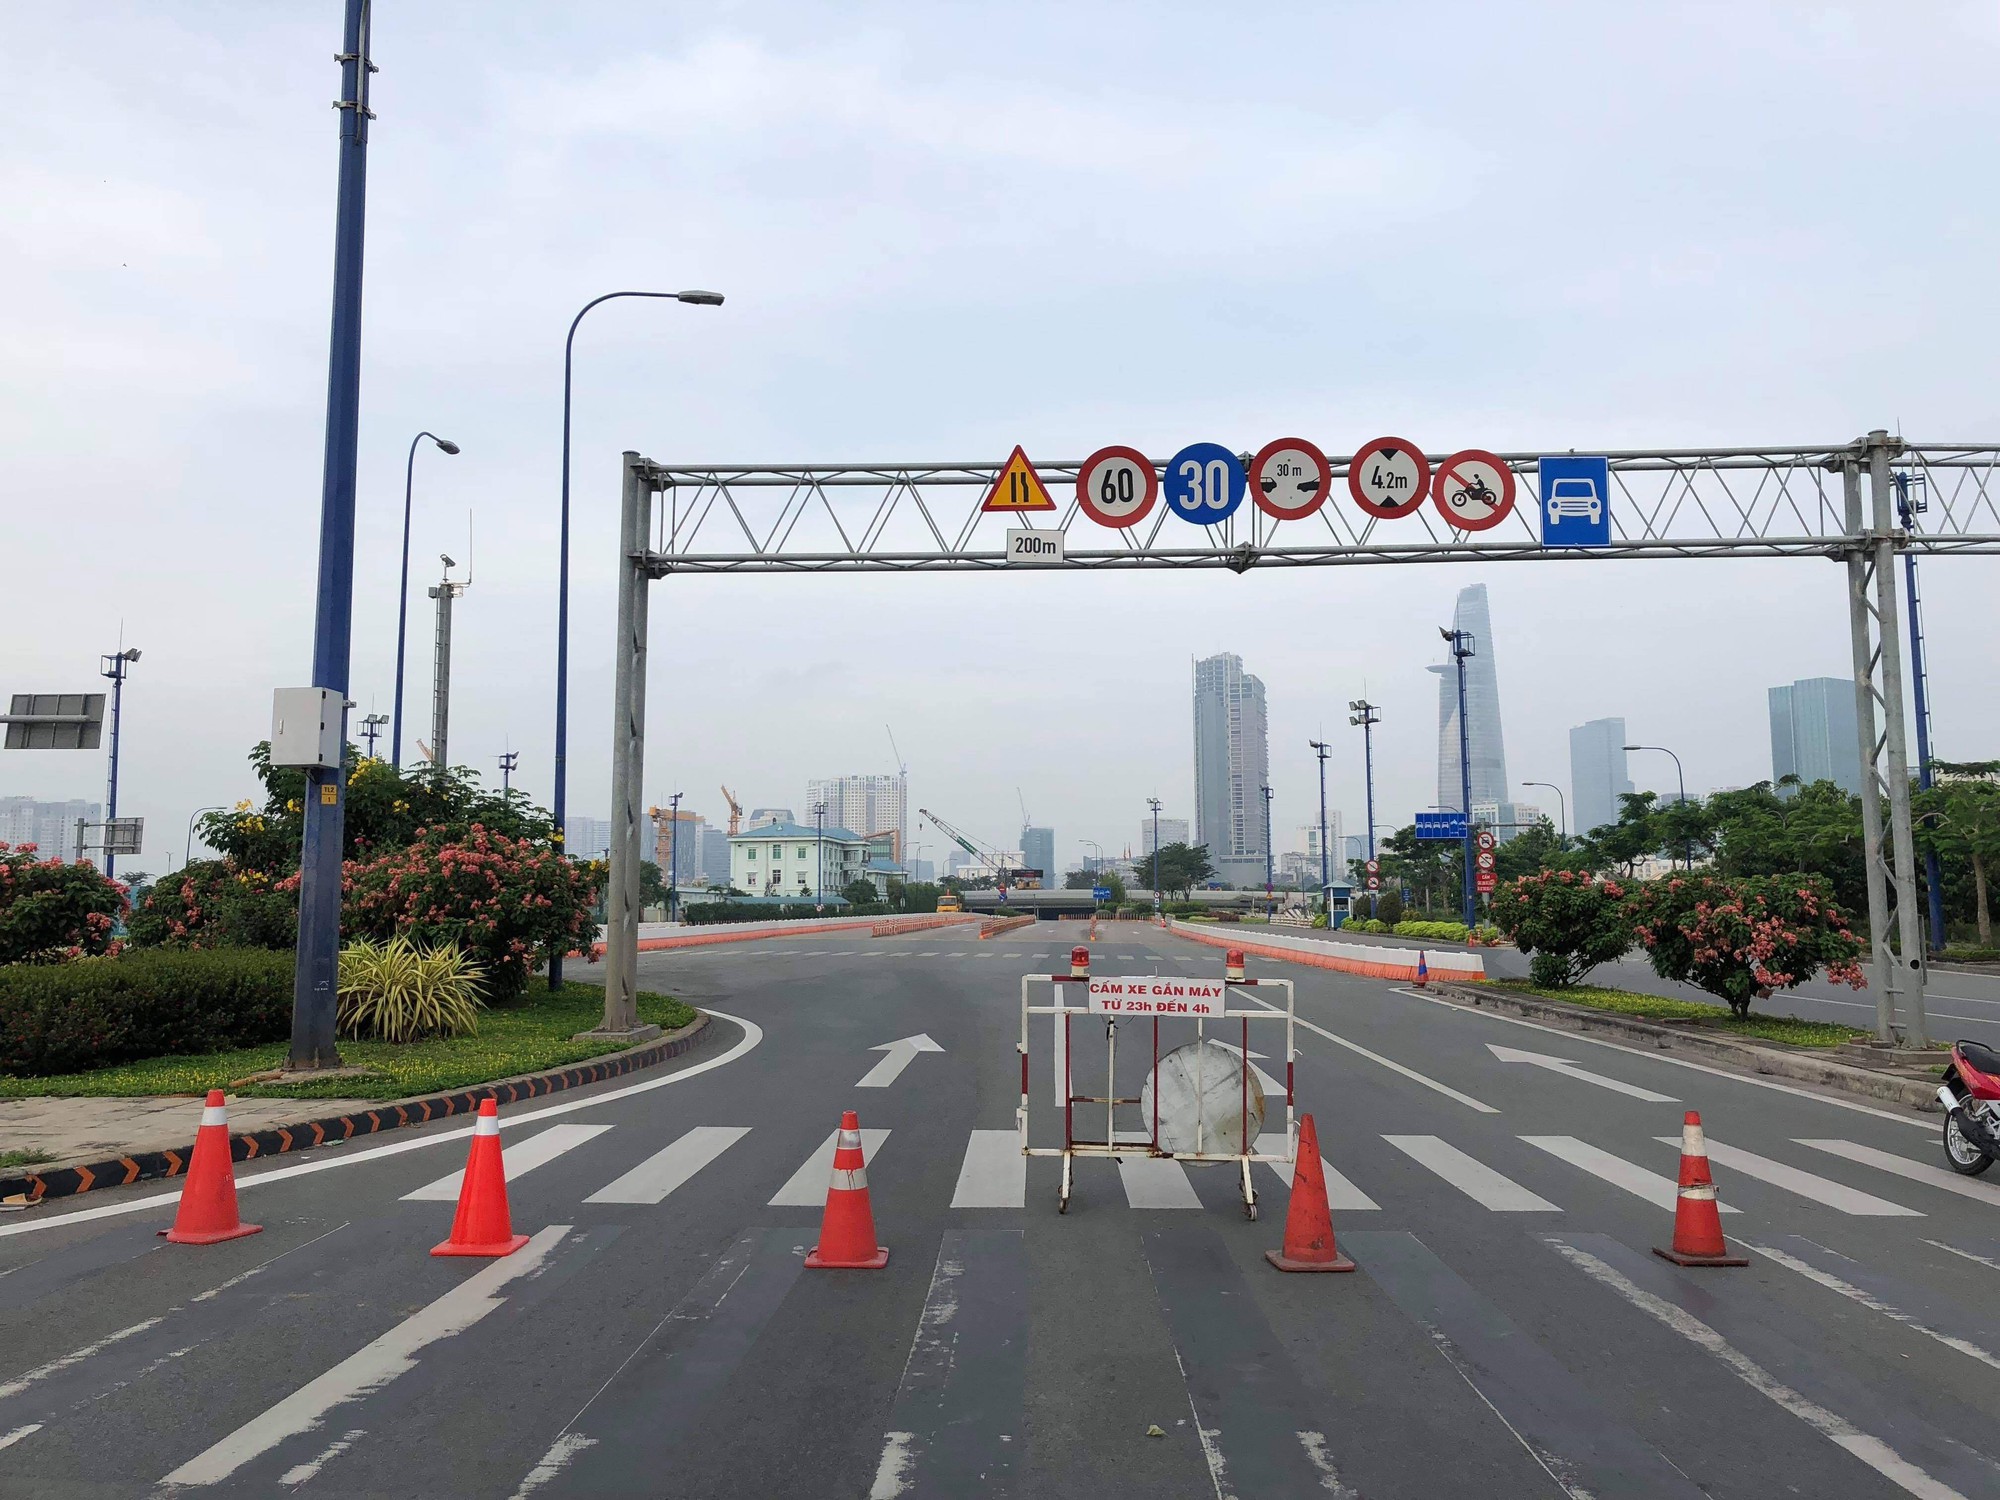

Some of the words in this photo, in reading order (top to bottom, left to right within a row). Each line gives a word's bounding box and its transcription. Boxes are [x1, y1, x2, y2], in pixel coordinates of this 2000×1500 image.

[1276, 463, 1289, 477] 30
[1292, 467, 1302, 477] m
[1371, 465, 1408, 489] 4.2m
[1101, 467, 1134, 504] 60
[1179, 459, 1229, 511] 30
[1015, 536, 1056, 554] 200m
[1090, 980, 1123, 994] CẤM
[1128, 985, 1147, 995] XE
[1152, 982, 1184, 996] GẮN
[1189, 985, 1222, 998] MÁY
[1102, 998, 1122, 1010] TỪ
[1126, 1001, 1152, 1012] 23h
[1156, 999, 1187, 1013] ĐẾN
[1192, 1003, 1210, 1014] 4h
